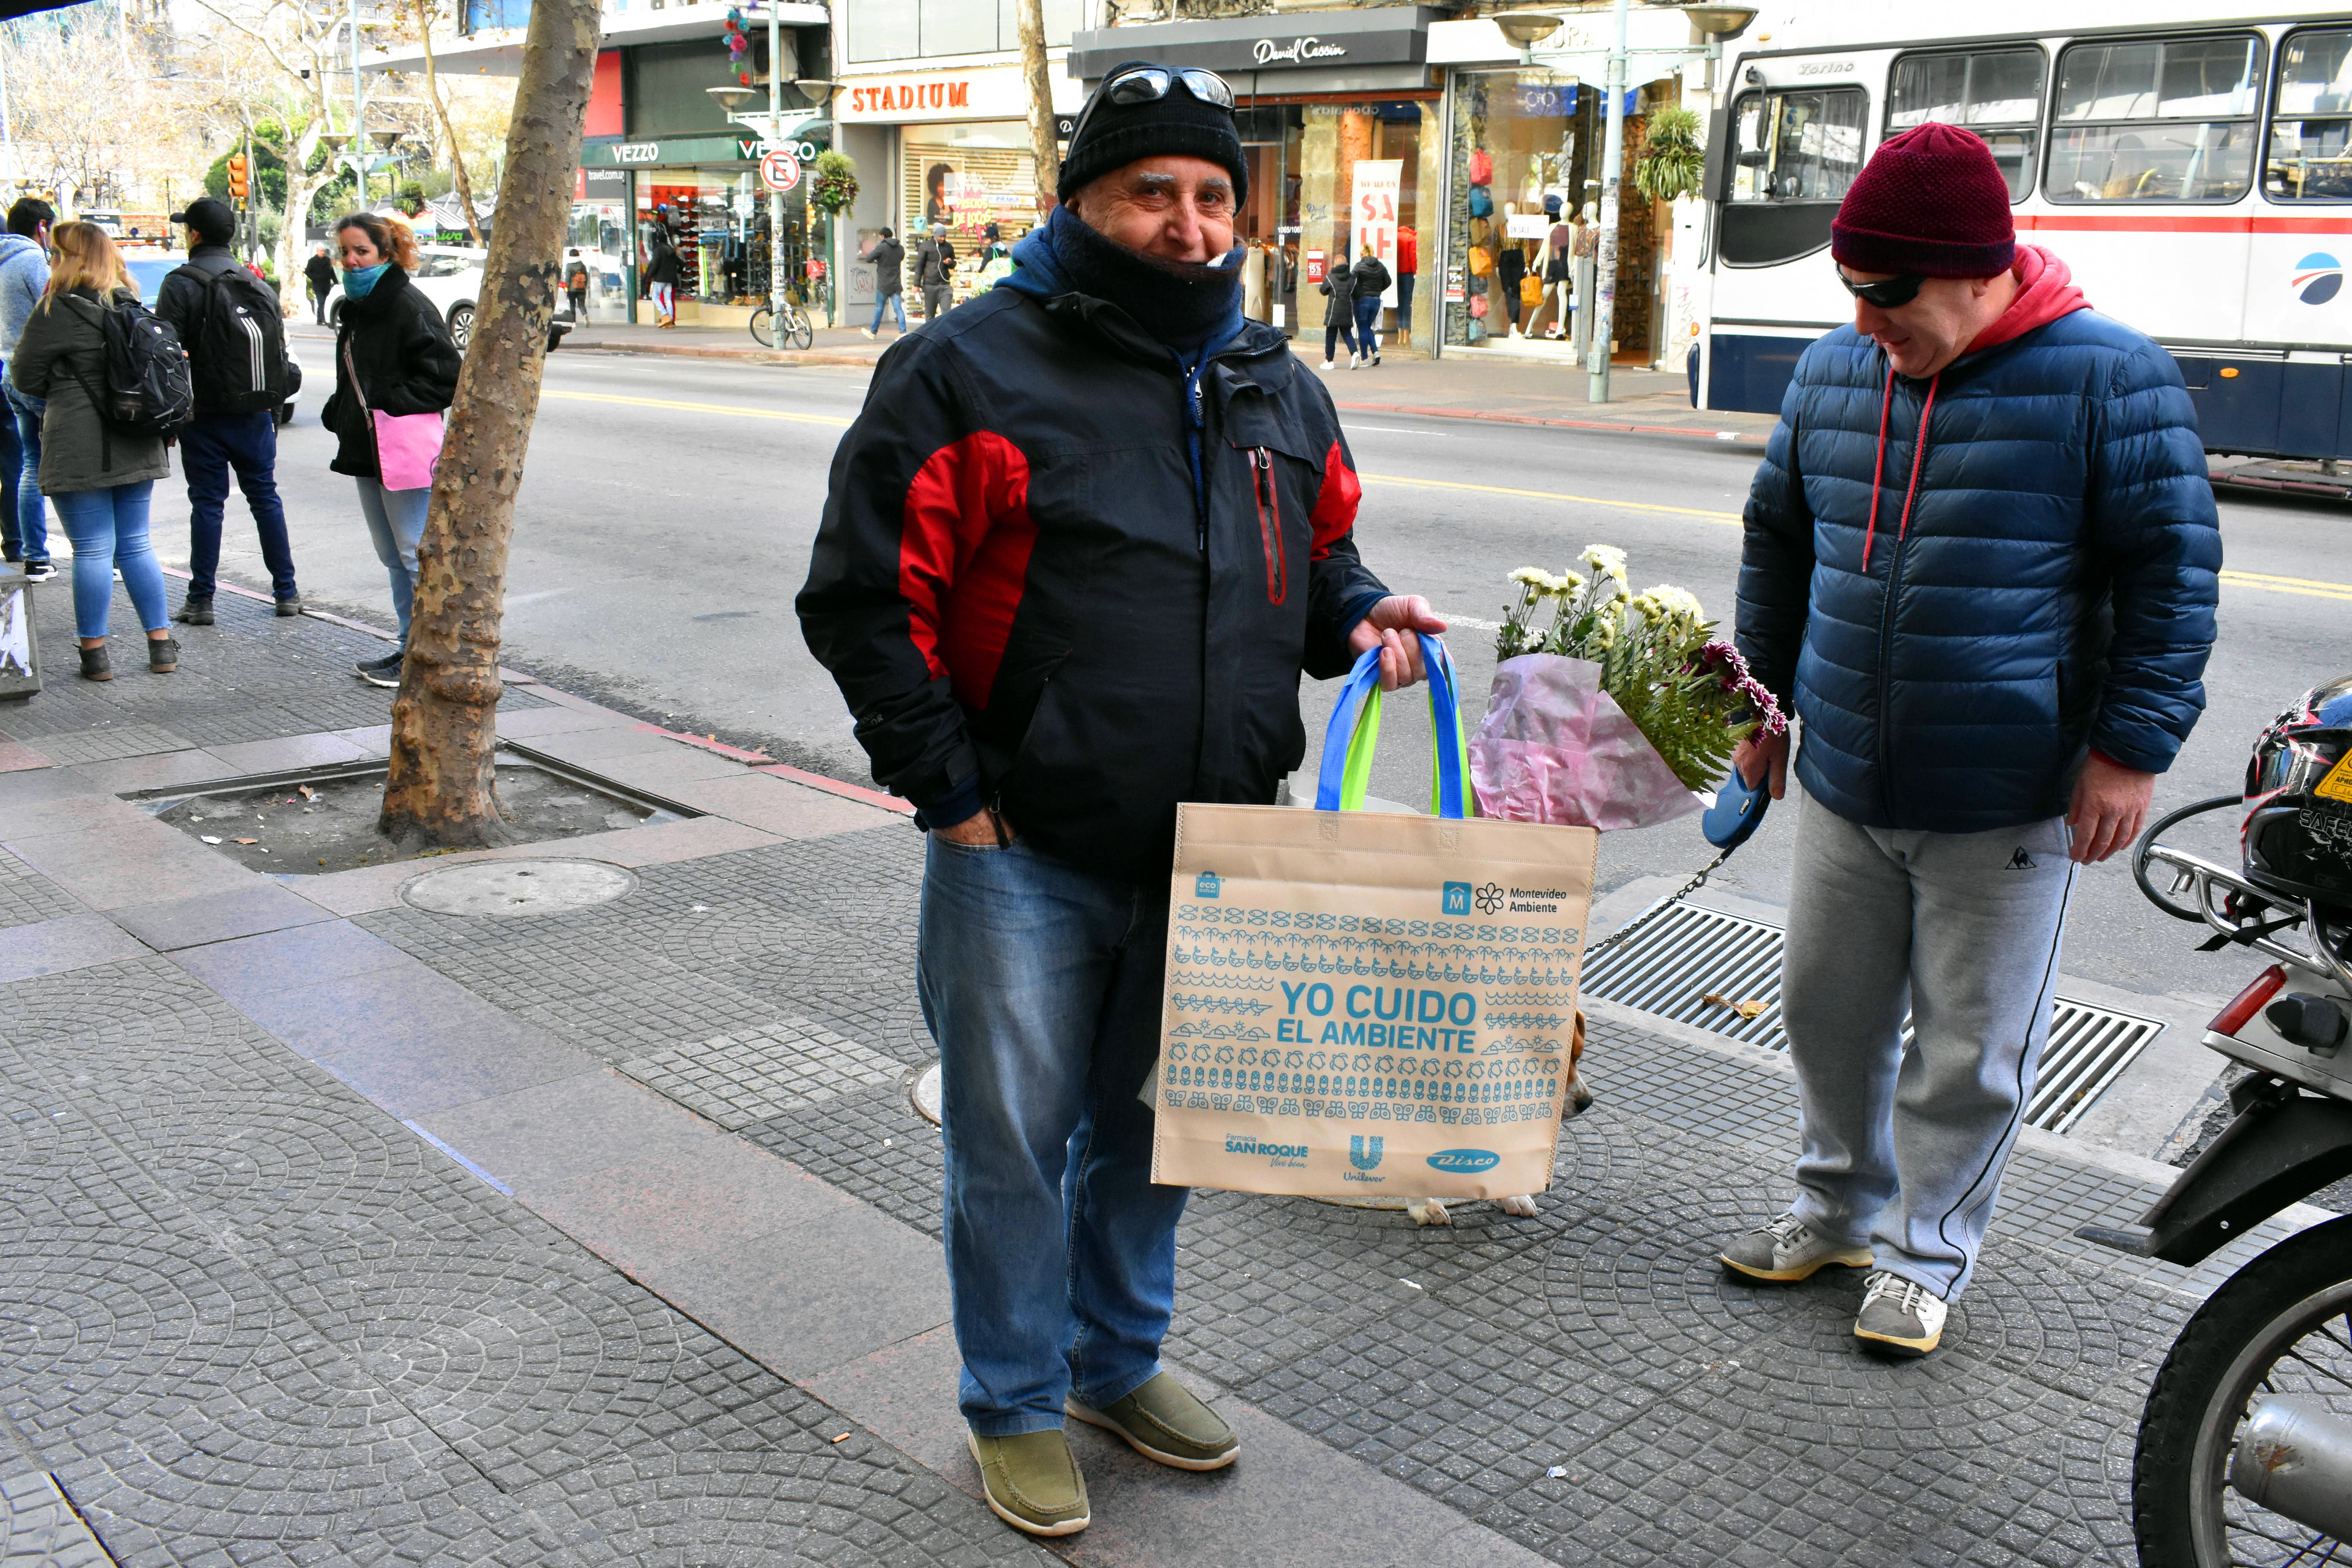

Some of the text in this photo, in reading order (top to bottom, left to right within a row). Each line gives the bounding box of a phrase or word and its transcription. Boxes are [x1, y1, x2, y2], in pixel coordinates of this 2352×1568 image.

[1530, 26, 1594, 49] AURA
[1254, 37, 1345, 64] Daniel Cassin
[1799, 63, 1854, 75] Torino
[852, 82, 969, 112] STADIUM
[612, 143, 658, 163] VEZZO
[956, 198, 989, 210] PRECIOS
[953, 209, 992, 228] DE LOCOS
[1308, 265, 1322, 273] 15%
[1448, 272, 1463, 283] 15%
[1510, 888, 1566, 899] Montevideo
[1509, 902, 1557, 913] Ambiente
[1280, 981, 1476, 1026] YO CUIDO
[1277, 1019, 1476, 1054] EL AMBIENTE
[1226, 1133, 1257, 1142] Farmacia
[1225, 1141, 1308, 1158] SAN ROQUE
[1430, 1155, 1494, 1166] Disco
[1343, 1172, 1386, 1183] Unilever
